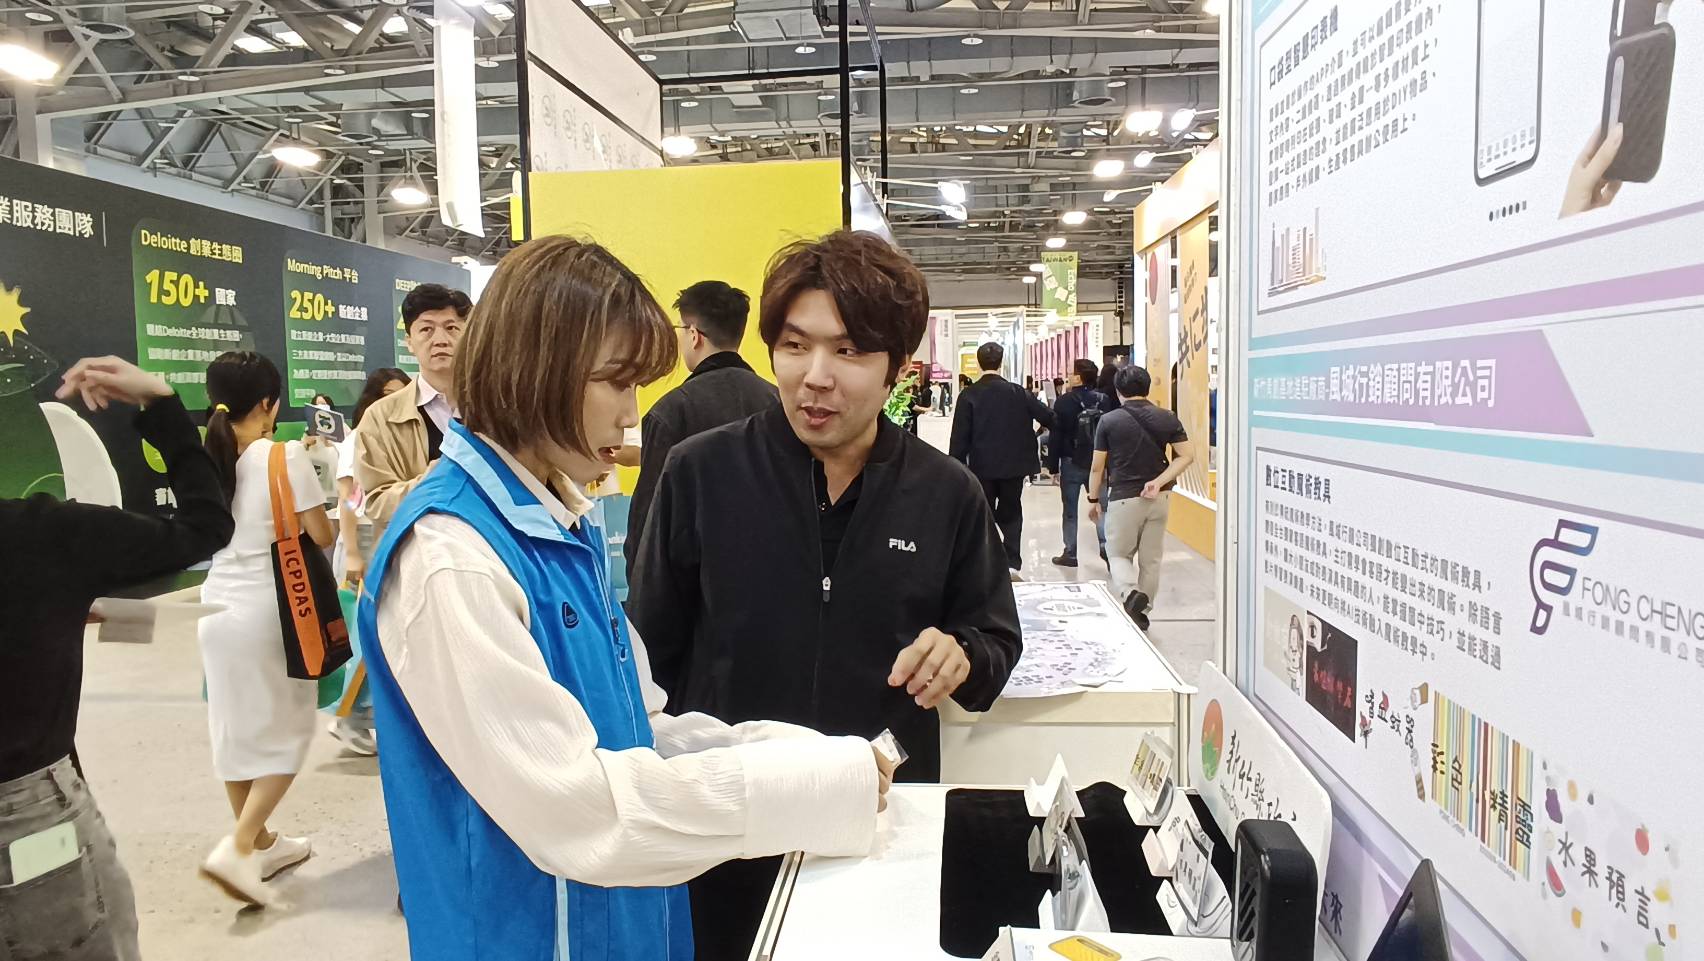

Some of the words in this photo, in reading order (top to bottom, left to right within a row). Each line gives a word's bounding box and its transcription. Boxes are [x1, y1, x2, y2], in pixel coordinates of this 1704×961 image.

[141, 229, 187, 253] Deloitte
[190, 238, 243, 264] 創業生態圈
[145, 269, 209, 307] 150+
[215, 288, 236, 306] 國家
[287, 257, 323, 280] Morning
[323, 264, 343, 280] Pitch
[343, 267, 359, 284] 平台
[289, 289, 336, 321] 250+
[339, 304, 368, 321] 新創企業
[1265, 464, 1331, 504] 數位互動魔術教具
[888, 537, 917, 553] FILA
[284, 549, 312, 619] ICPDAS
[1582, 576, 1631, 615] FONG
[1636, 594, 1704, 641] CHENG
[1557, 831, 1651, 930] 水果預言
